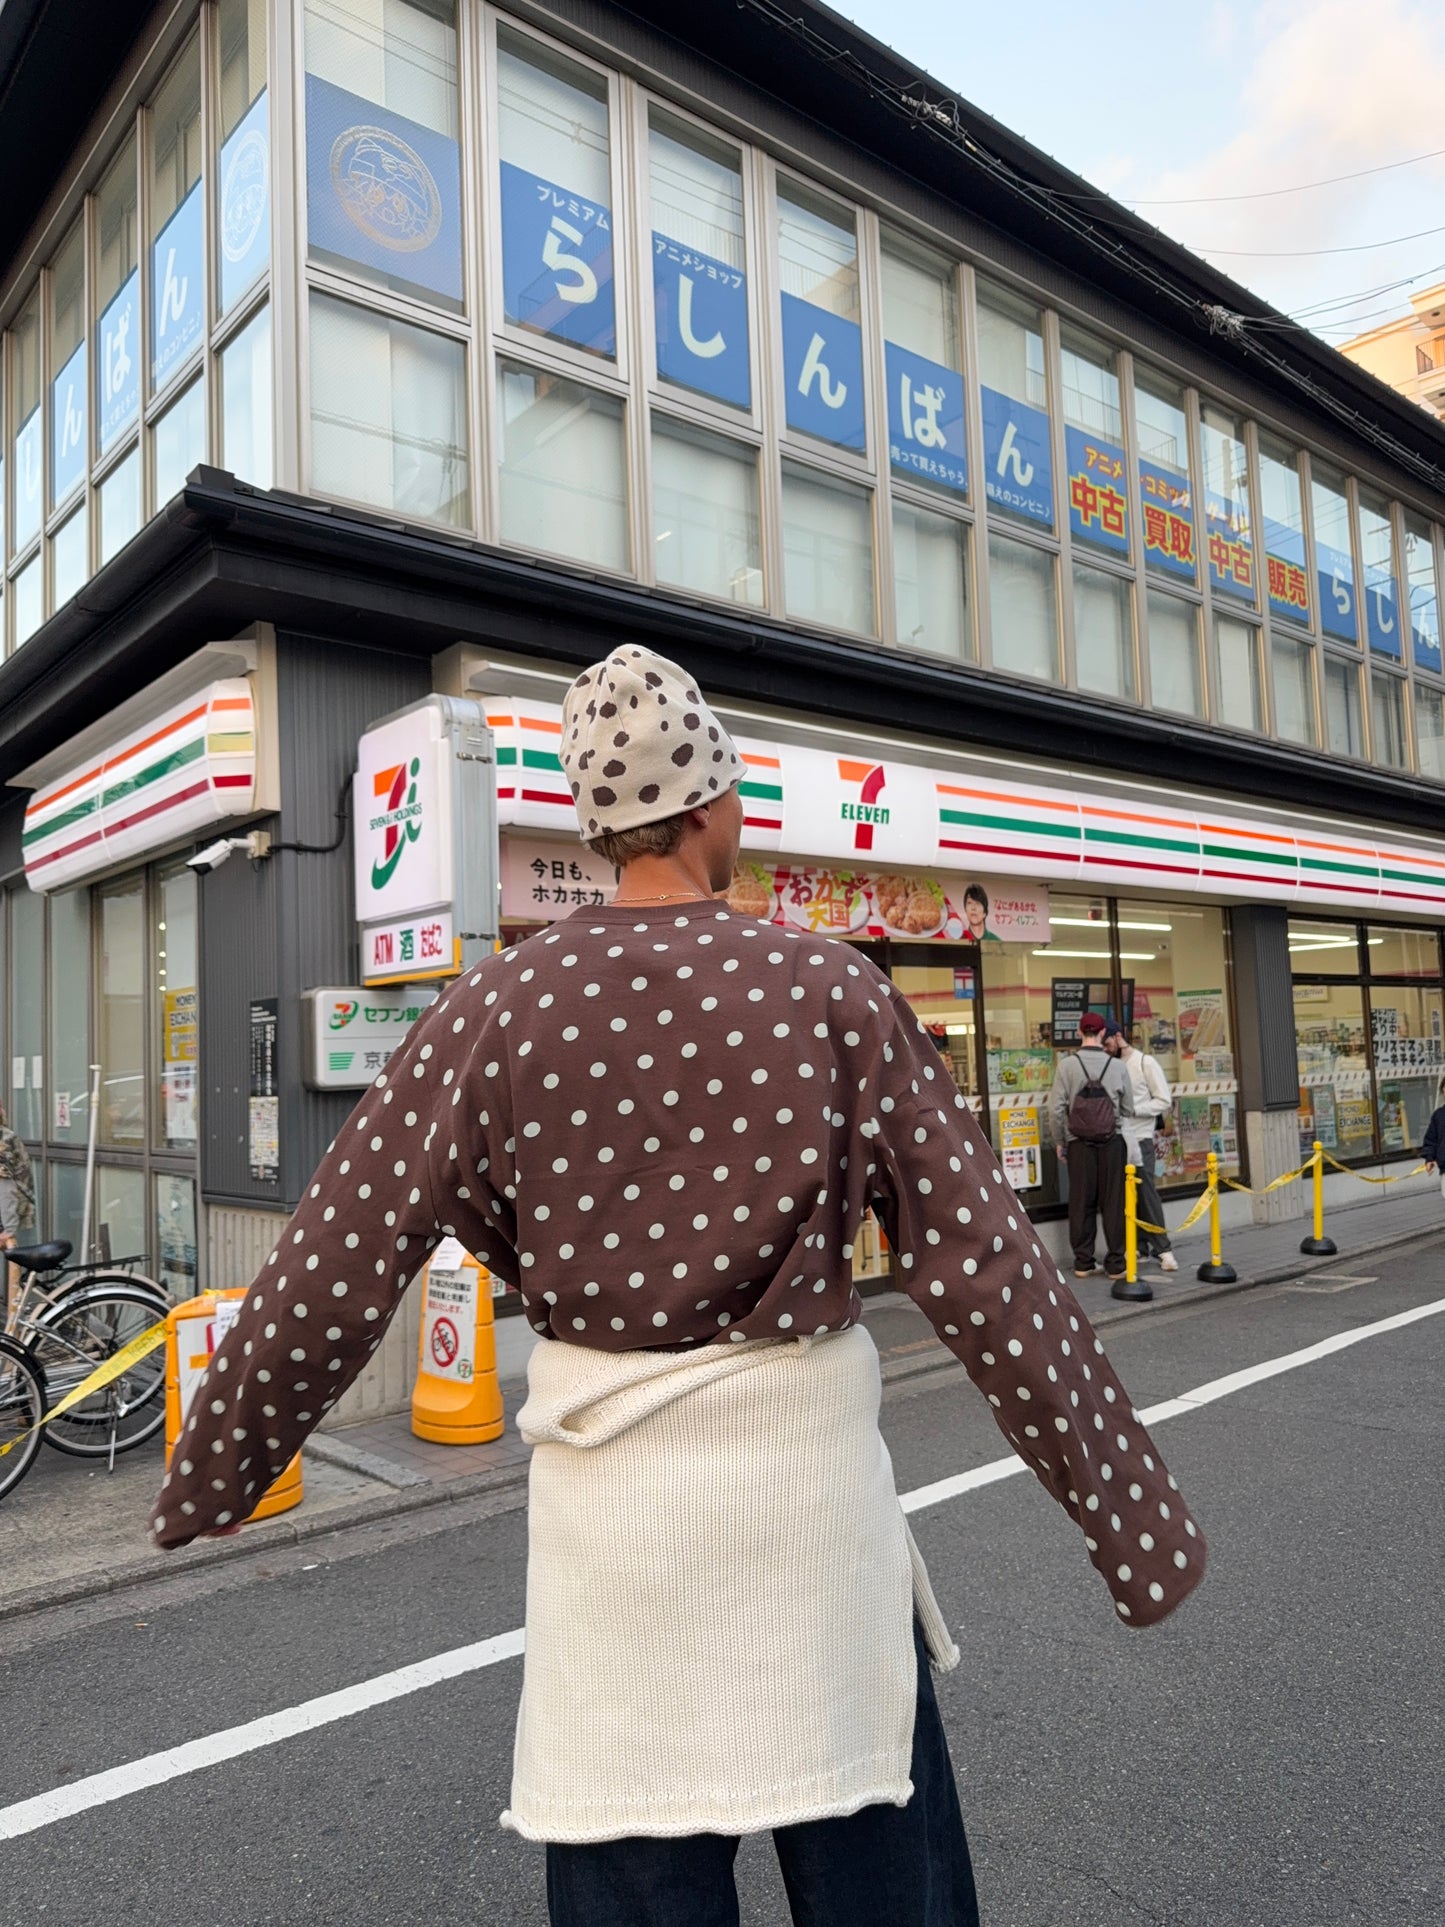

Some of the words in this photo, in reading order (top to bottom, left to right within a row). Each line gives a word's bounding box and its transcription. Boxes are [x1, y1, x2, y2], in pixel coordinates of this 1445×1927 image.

[536, 185, 610, 231] プレミアム
[654, 239, 743, 289] アニメショップ
[541, 215, 598, 304] ら
[677, 273, 727, 359] し
[798, 333, 848, 410] ん
[901, 372, 947, 449] ば
[996, 421, 1034, 487] ん
[1084, 445, 1123, 479] アニメ
[1069, 472, 1127, 539] 中古
[1143, 502, 1196, 567] 買取
[1208, 531, 1253, 588] 中古
[1266, 555, 1308, 610] 販売
[393, 802, 422, 824] HOLDINGS
[530, 858, 592, 881] 今日も、
[789, 871, 869, 908] おかず
[804, 899, 850, 932] 天国
[374, 932, 394, 966] ATM
[400, 928, 414, 963] 酒
[420, 923, 443, 959] たばこ
[169, 1010, 197, 1026] EXCHAN
[1002, 1120, 1036, 1129] EXCHANGE
